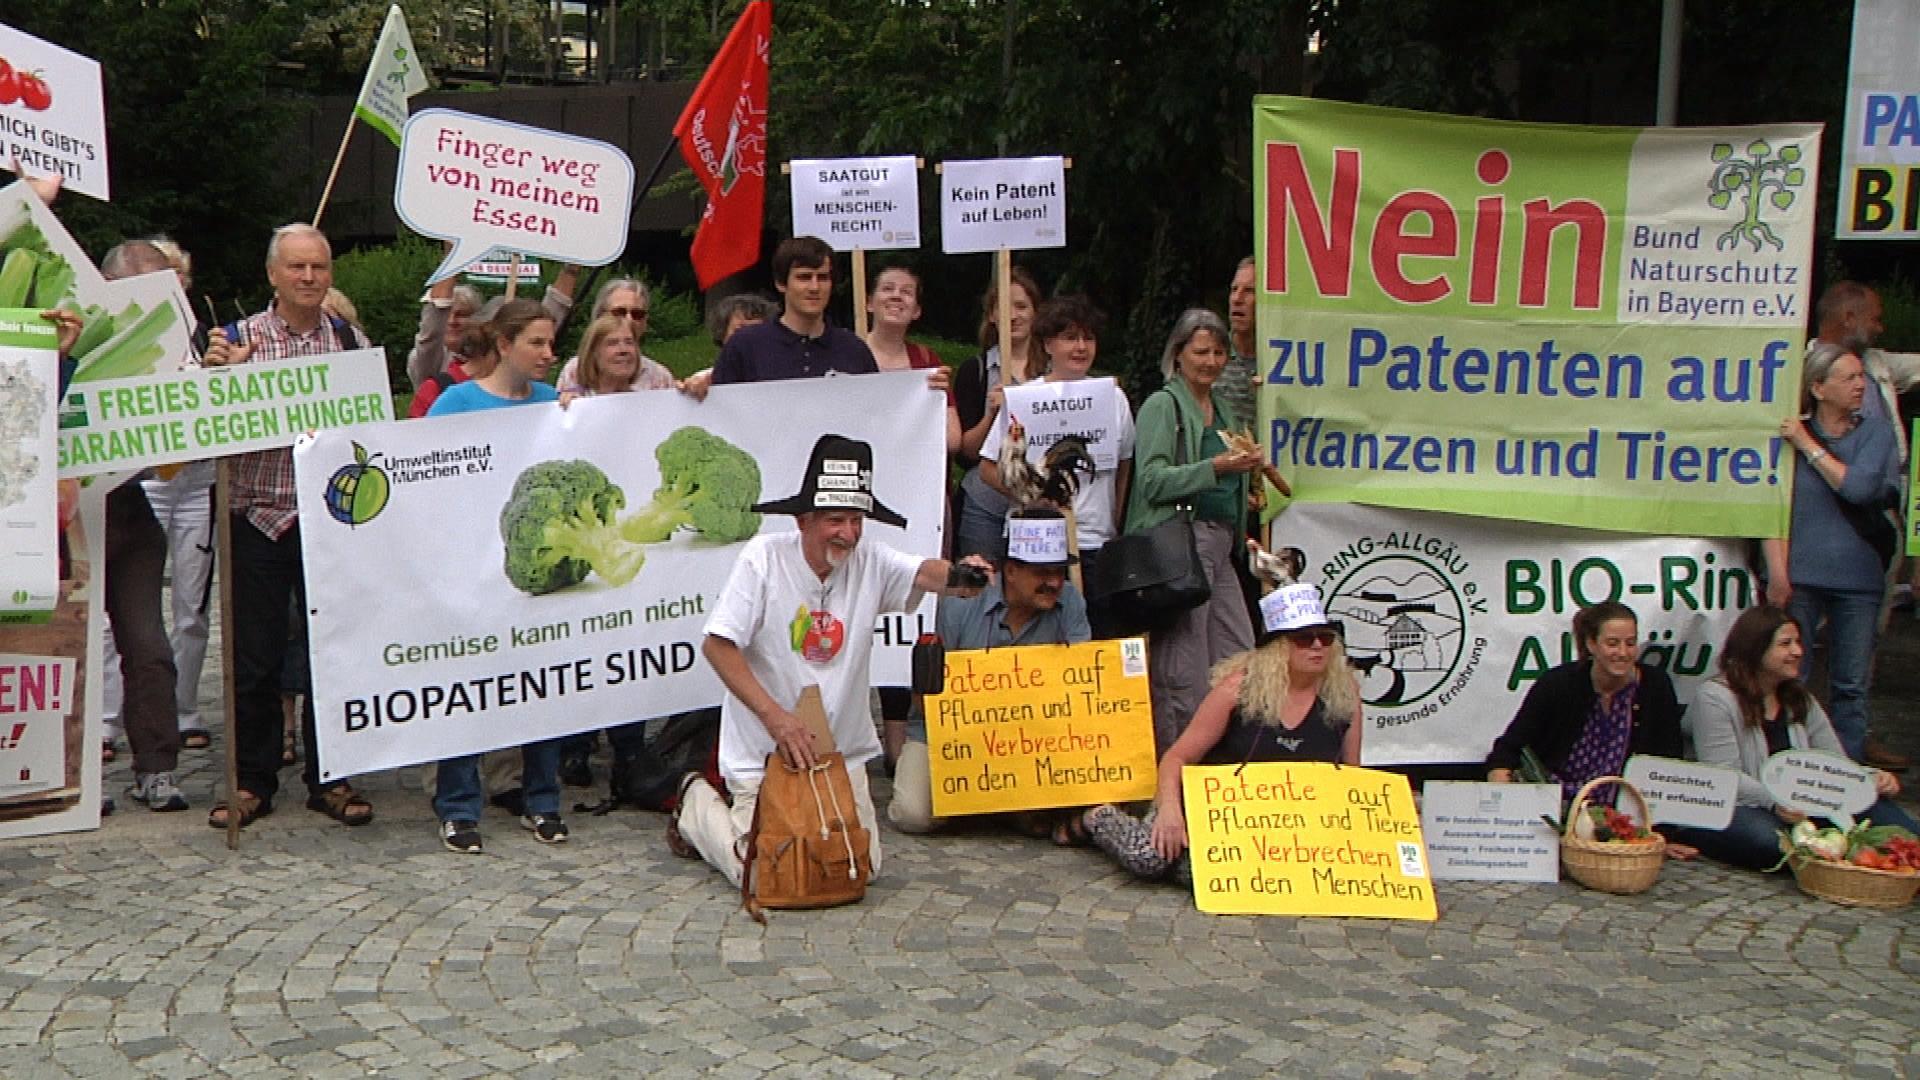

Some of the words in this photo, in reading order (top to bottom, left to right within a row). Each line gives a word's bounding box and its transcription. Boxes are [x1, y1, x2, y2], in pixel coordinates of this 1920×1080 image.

[11, 144, 81, 181] PATENT!
[42, 129, 94, 160] GIBT'S
[437, 128, 532, 168] Finger
[542, 154, 600, 188] weg
[428, 163, 480, 191] von
[490, 177, 600, 214] meinem
[819, 168, 889, 182] SAATGUT
[952, 187, 989, 202] Kein
[996, 181, 1056, 200] Patent
[473, 200, 558, 237] Essen
[814, 201, 898, 215] MENSCHEN-
[831, 220, 882, 232] RECHT!
[962, 208, 988, 224] auf
[993, 204, 1048, 222] Leben!
[1264, 141, 1607, 311] Nein
[1633, 225, 1700, 250] Bund
[1630, 257, 1798, 286] Naturschutz
[1628, 290, 1649, 313] in
[1658, 291, 1745, 320] Bayern
[1753, 294, 1796, 317] e.V.
[1267, 339, 1325, 387] zu
[1347, 328, 1644, 398] Patenten
[1666, 341, 1789, 403] auf
[98, 379, 199, 421] FREIES
[209, 364, 330, 408] SAATGUT
[1031, 397, 1092, 415] SAATGUT
[196, 406, 280, 447] GEGEN
[287, 393, 385, 434] HUNGER
[384, 444, 492, 470] Umweltinstitut
[1270, 417, 1476, 474] Pflanzen
[1495, 428, 1599, 479] und
[1617, 431, 1780, 484] Tiere!
[392, 465, 461, 484] München
[466, 458, 494, 475] e.V.
[1315, 531, 1469, 600] -RING-ALLGÄU
[1506, 552, 1752, 615] BIO-Rin
[383, 632, 498, 667] Gemüse
[510, 621, 570, 648] kann
[581, 608, 633, 635] man
[646, 593, 704, 622] nicht
[1062, 649, 1105, 694] auf
[1507, 630, 1712, 692] Aläu
[344, 657, 594, 733] BIOPATENTE
[605, 641, 695, 685] SIND
[939, 699, 1033, 730] Pflanzen
[1042, 692, 1072, 719] und
[1376, 703, 1439, 730] gesunde
[942, 741, 972, 761] ein
[982, 724, 1110, 757] Verbrechen
[943, 776, 968, 794] an
[977, 764, 1016, 792] den
[1035, 756, 1132, 787] Menschen
[1824, 765, 1866, 782] Nahrung
[1204, 769, 1316, 804] Patente
[1348, 783, 1391, 816] auf
[1667, 794, 1724, 808] erfunden!
[1209, 805, 1306, 834] Pflanzen
[1320, 808, 1352, 831] und
[1207, 841, 1242, 863] ein
[1252, 834, 1392, 867] Verbrechen
[1209, 875, 1240, 894] an
[1250, 868, 1292, 894] den
[1312, 868, 1423, 901] Menschen
